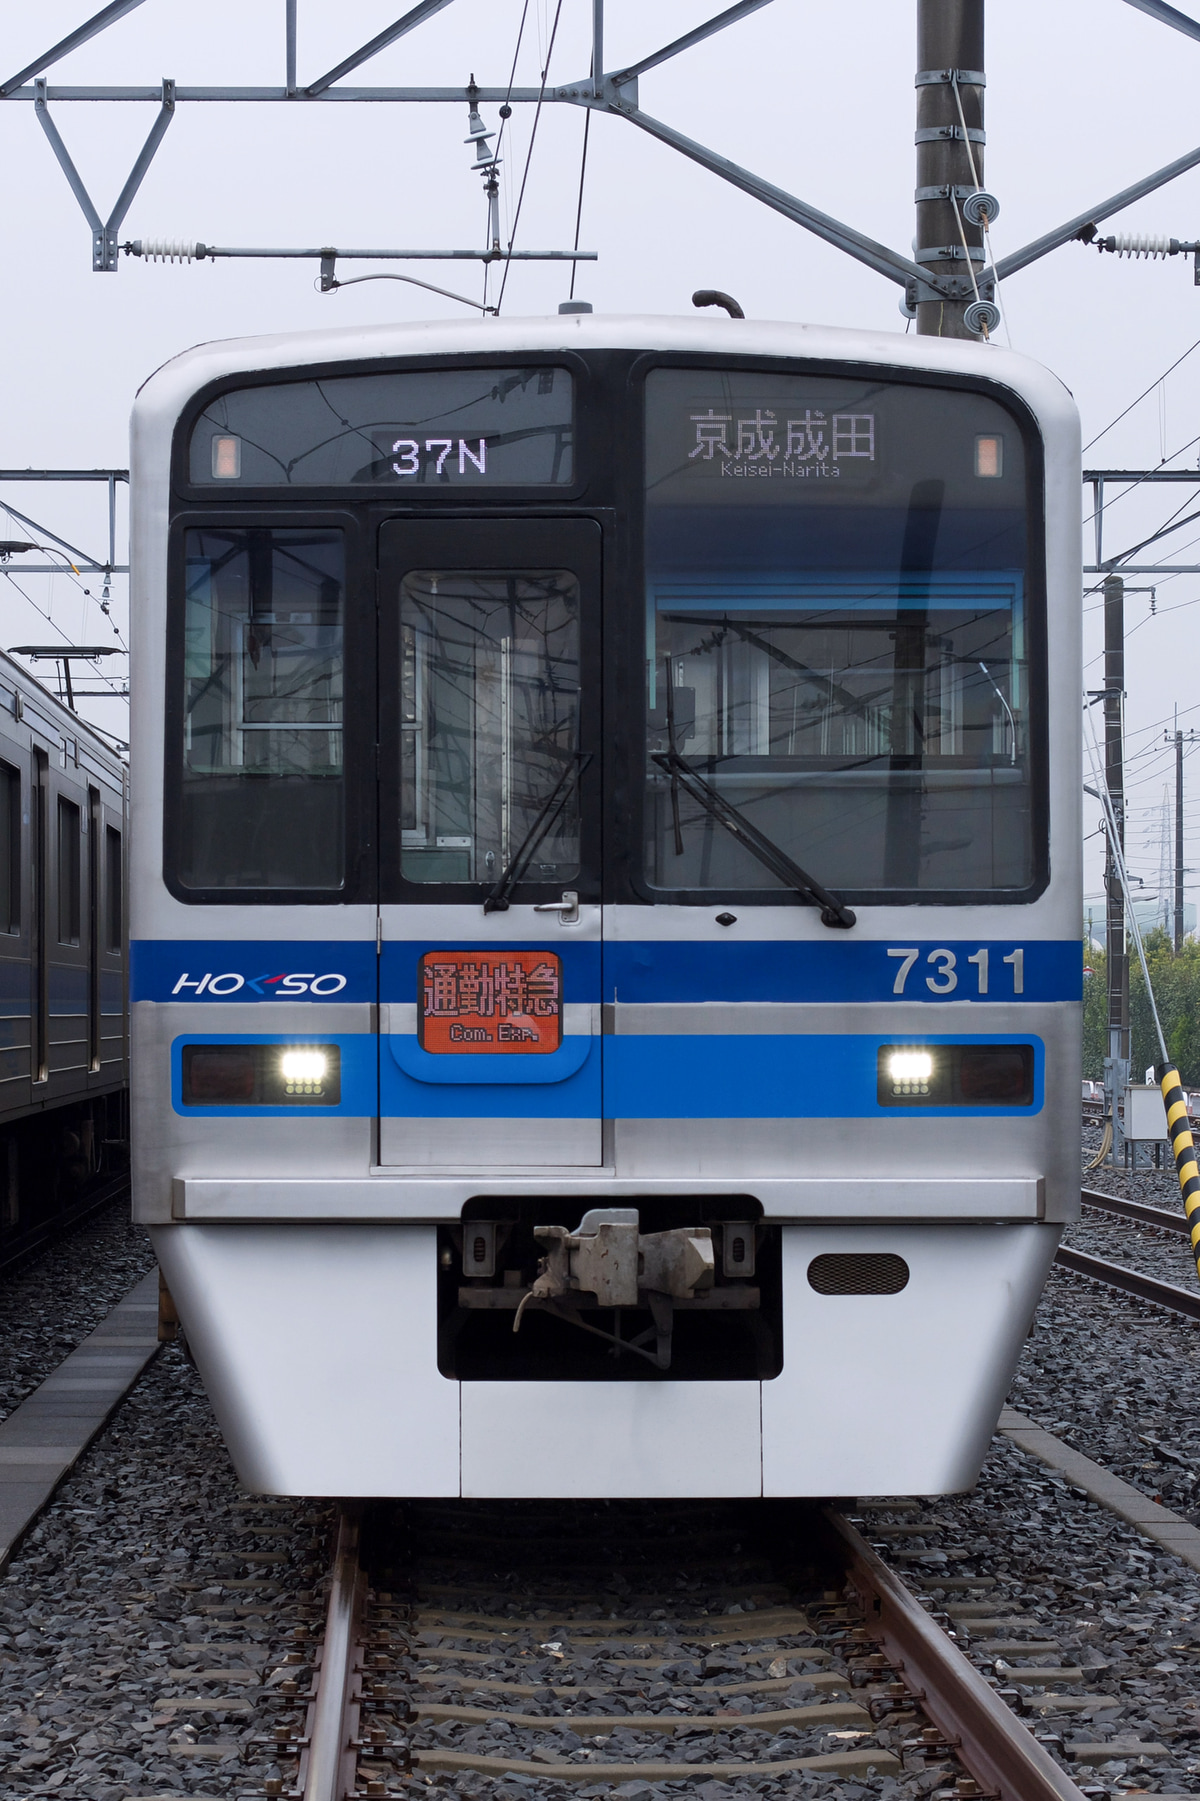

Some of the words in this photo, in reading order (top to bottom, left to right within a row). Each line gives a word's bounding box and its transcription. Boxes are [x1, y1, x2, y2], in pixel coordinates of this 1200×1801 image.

[688, 409, 875, 460] 京成成田
[392, 439, 486, 475] 37N
[721, 461, 840, 477] Keisei-Narita
[423, 963, 559, 1016] 通勤特急
[887, 948, 1024, 994] 7311
[450, 1023, 493, 1041] Com.
